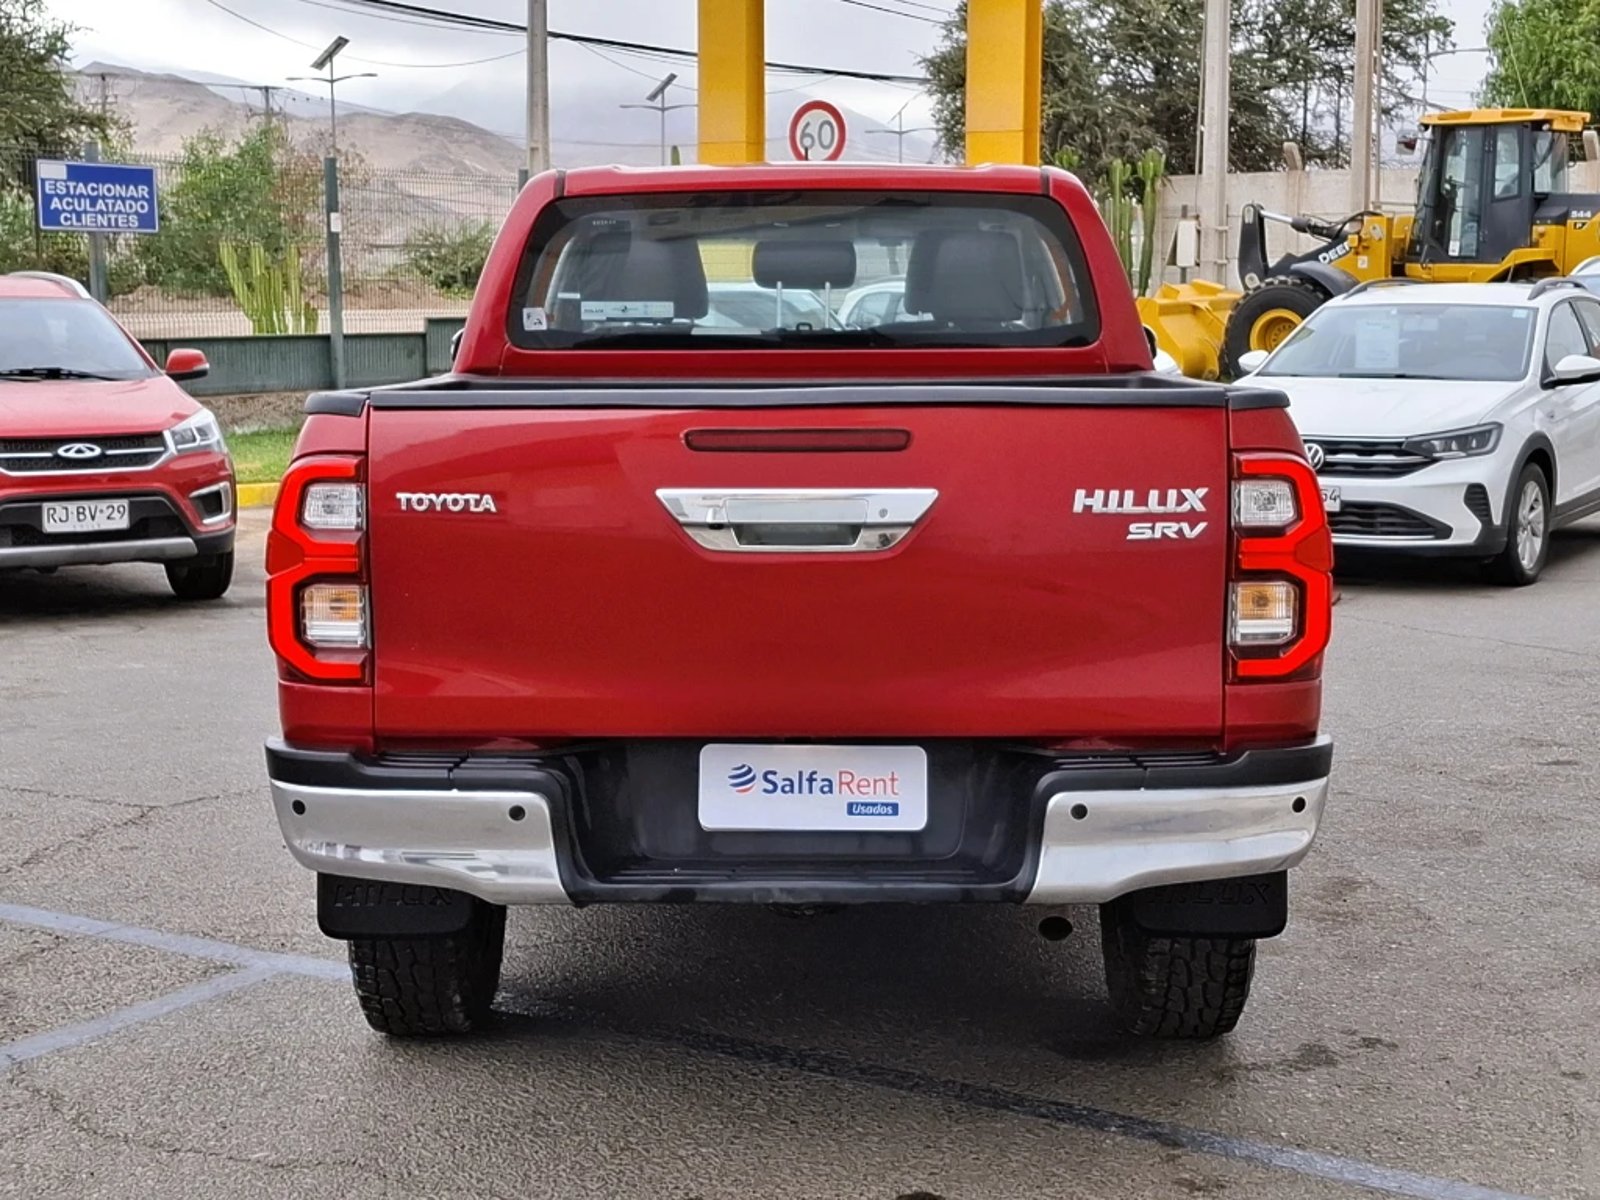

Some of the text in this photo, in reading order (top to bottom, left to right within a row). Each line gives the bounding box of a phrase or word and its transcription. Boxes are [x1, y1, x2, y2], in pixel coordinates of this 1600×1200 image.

[800, 120, 835, 150] 60
[45, 180, 149, 198] ESTACIONAR
[50, 197, 149, 213] ACULATADO
[60, 213, 139, 228] CLIENTES
[395, 492, 497, 513] TOYOTA
[1073, 487, 1209, 514] HILUX
[1126, 521, 1208, 540] SRV
[762, 770, 899, 796] SalfaRent
[852, 804, 893, 815] Usados
